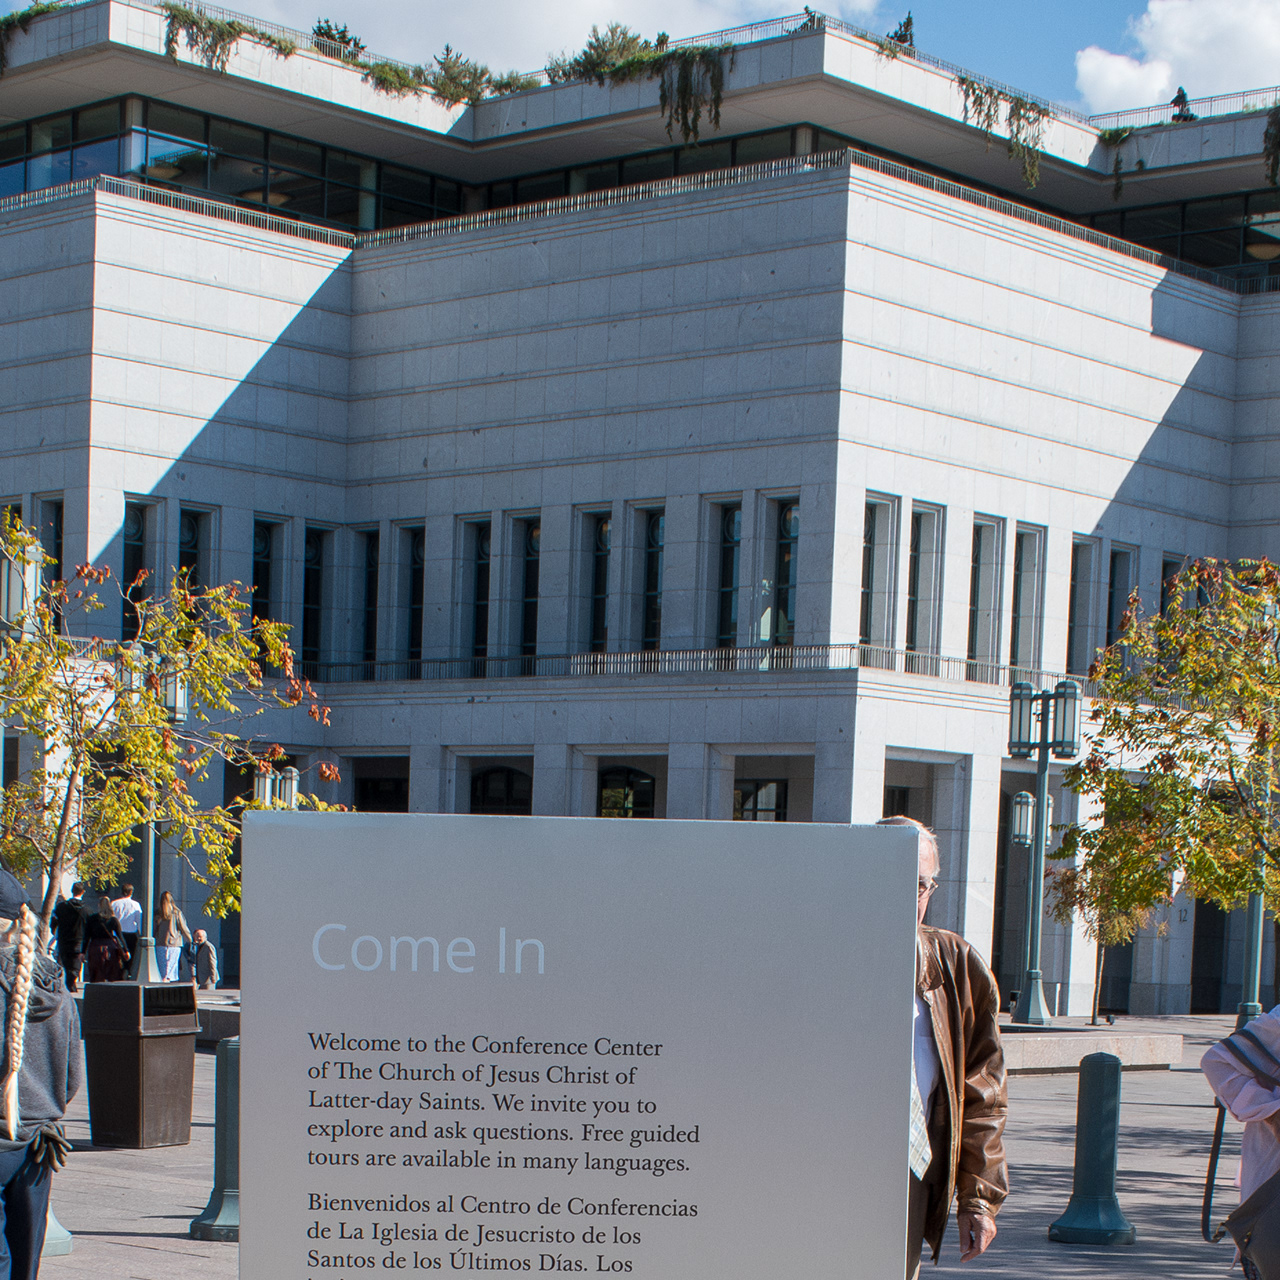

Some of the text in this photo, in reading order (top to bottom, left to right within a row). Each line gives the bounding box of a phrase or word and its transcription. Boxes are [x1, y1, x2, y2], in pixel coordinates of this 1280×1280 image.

[1178, 908, 1188, 922] 12
[312, 923, 545, 975] Come In
[307, 1032, 664, 1057] Welcome to the Conference Center
[307, 1060, 639, 1088] of The Church of Jesus Christ of
[308, 1089, 657, 1119] Latter-day Saints. We invite you to
[307, 1118, 701, 1149] explore and ask questions. Free guided
[307, 1148, 690, 1178] tours are available in many languages.
[307, 1192, 698, 1218] Bienvenidos al Centro de Conferencias
[306, 1220, 642, 1248] de La Iglesia de Jesucristo de los
[307, 1247, 633, 1273] Santos de los Últimos Días. Los
